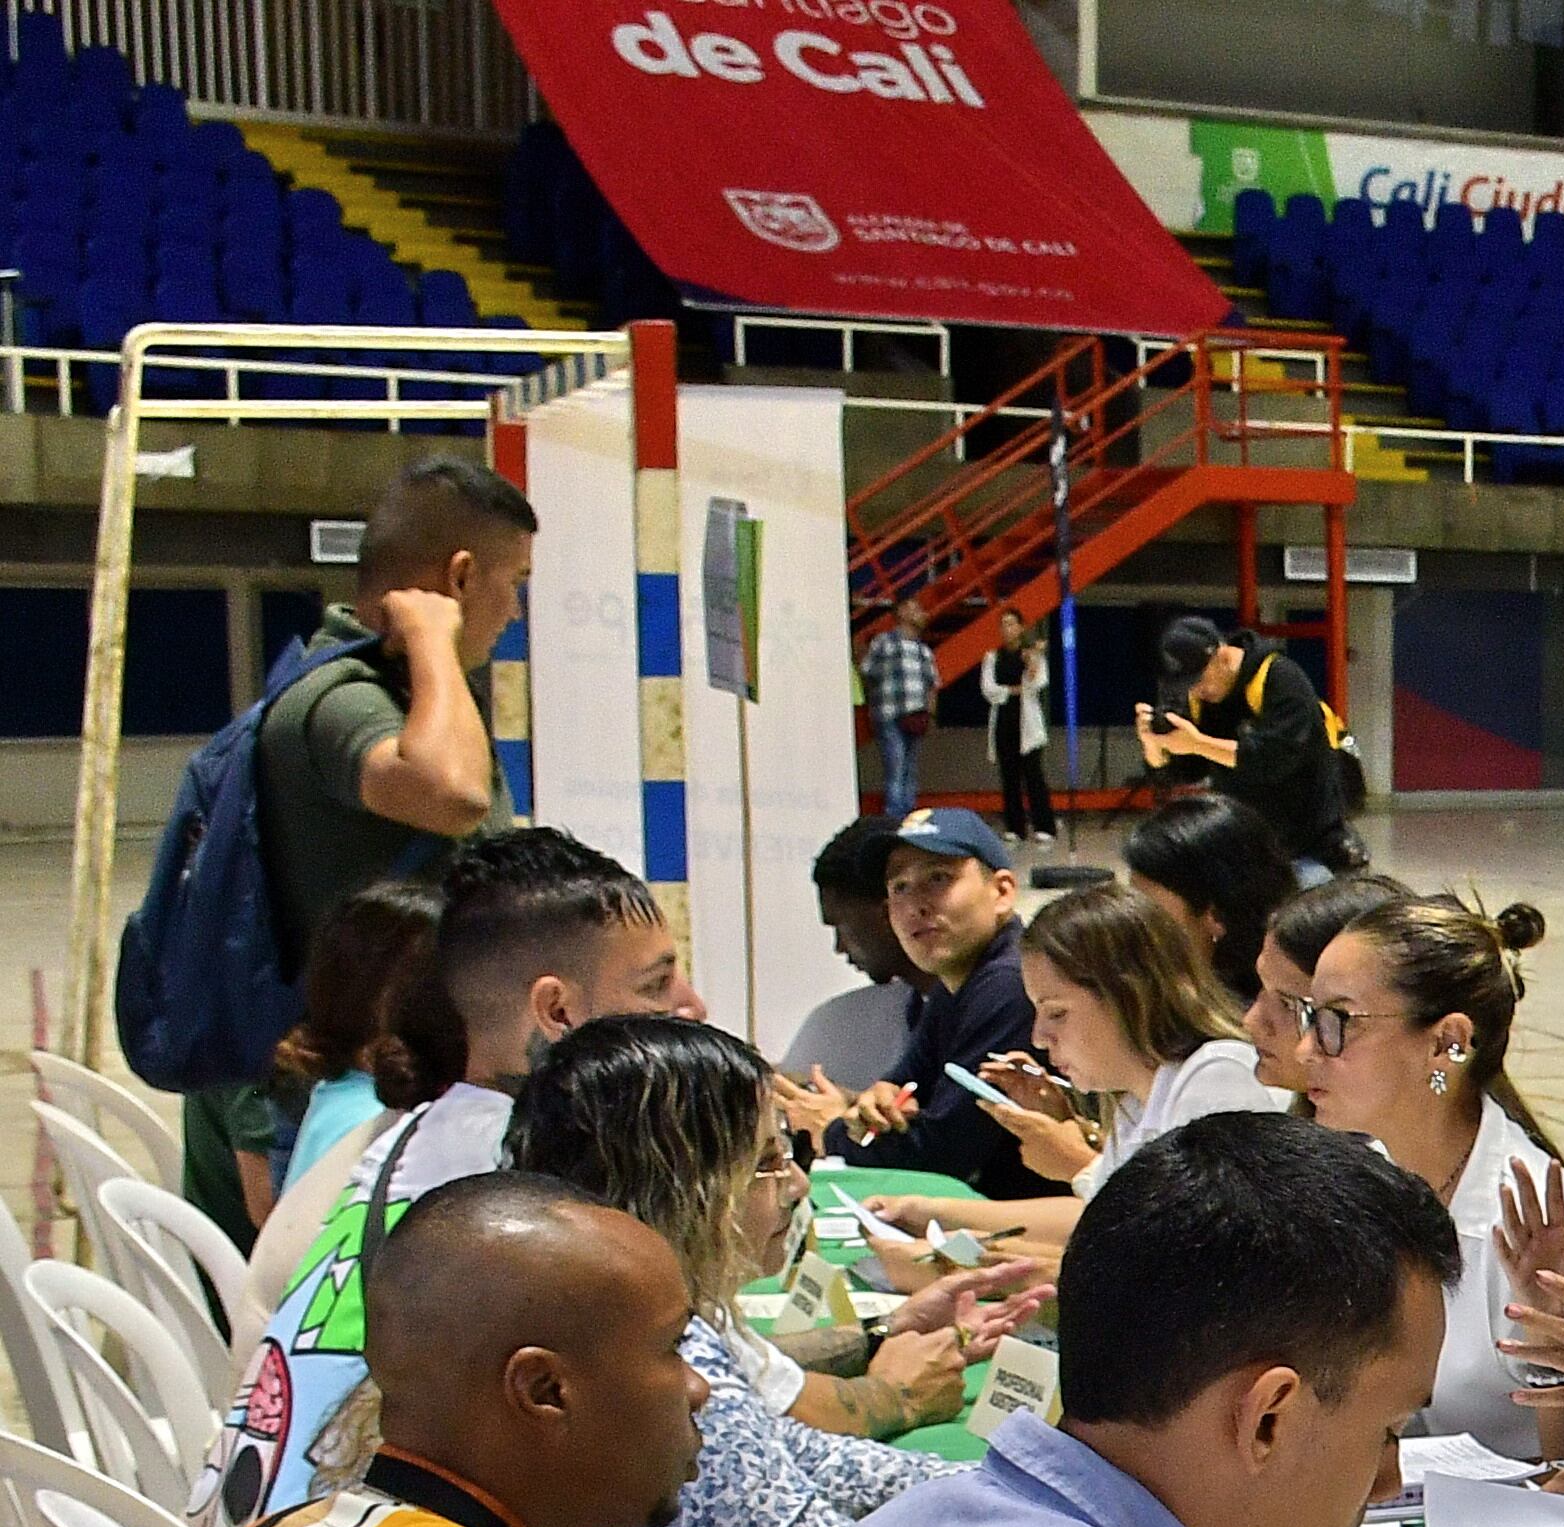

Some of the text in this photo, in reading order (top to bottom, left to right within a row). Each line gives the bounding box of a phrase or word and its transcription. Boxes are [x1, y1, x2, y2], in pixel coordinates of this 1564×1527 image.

[611, 10, 985, 108] de Cali
[1358, 164, 1451, 212] Cali
